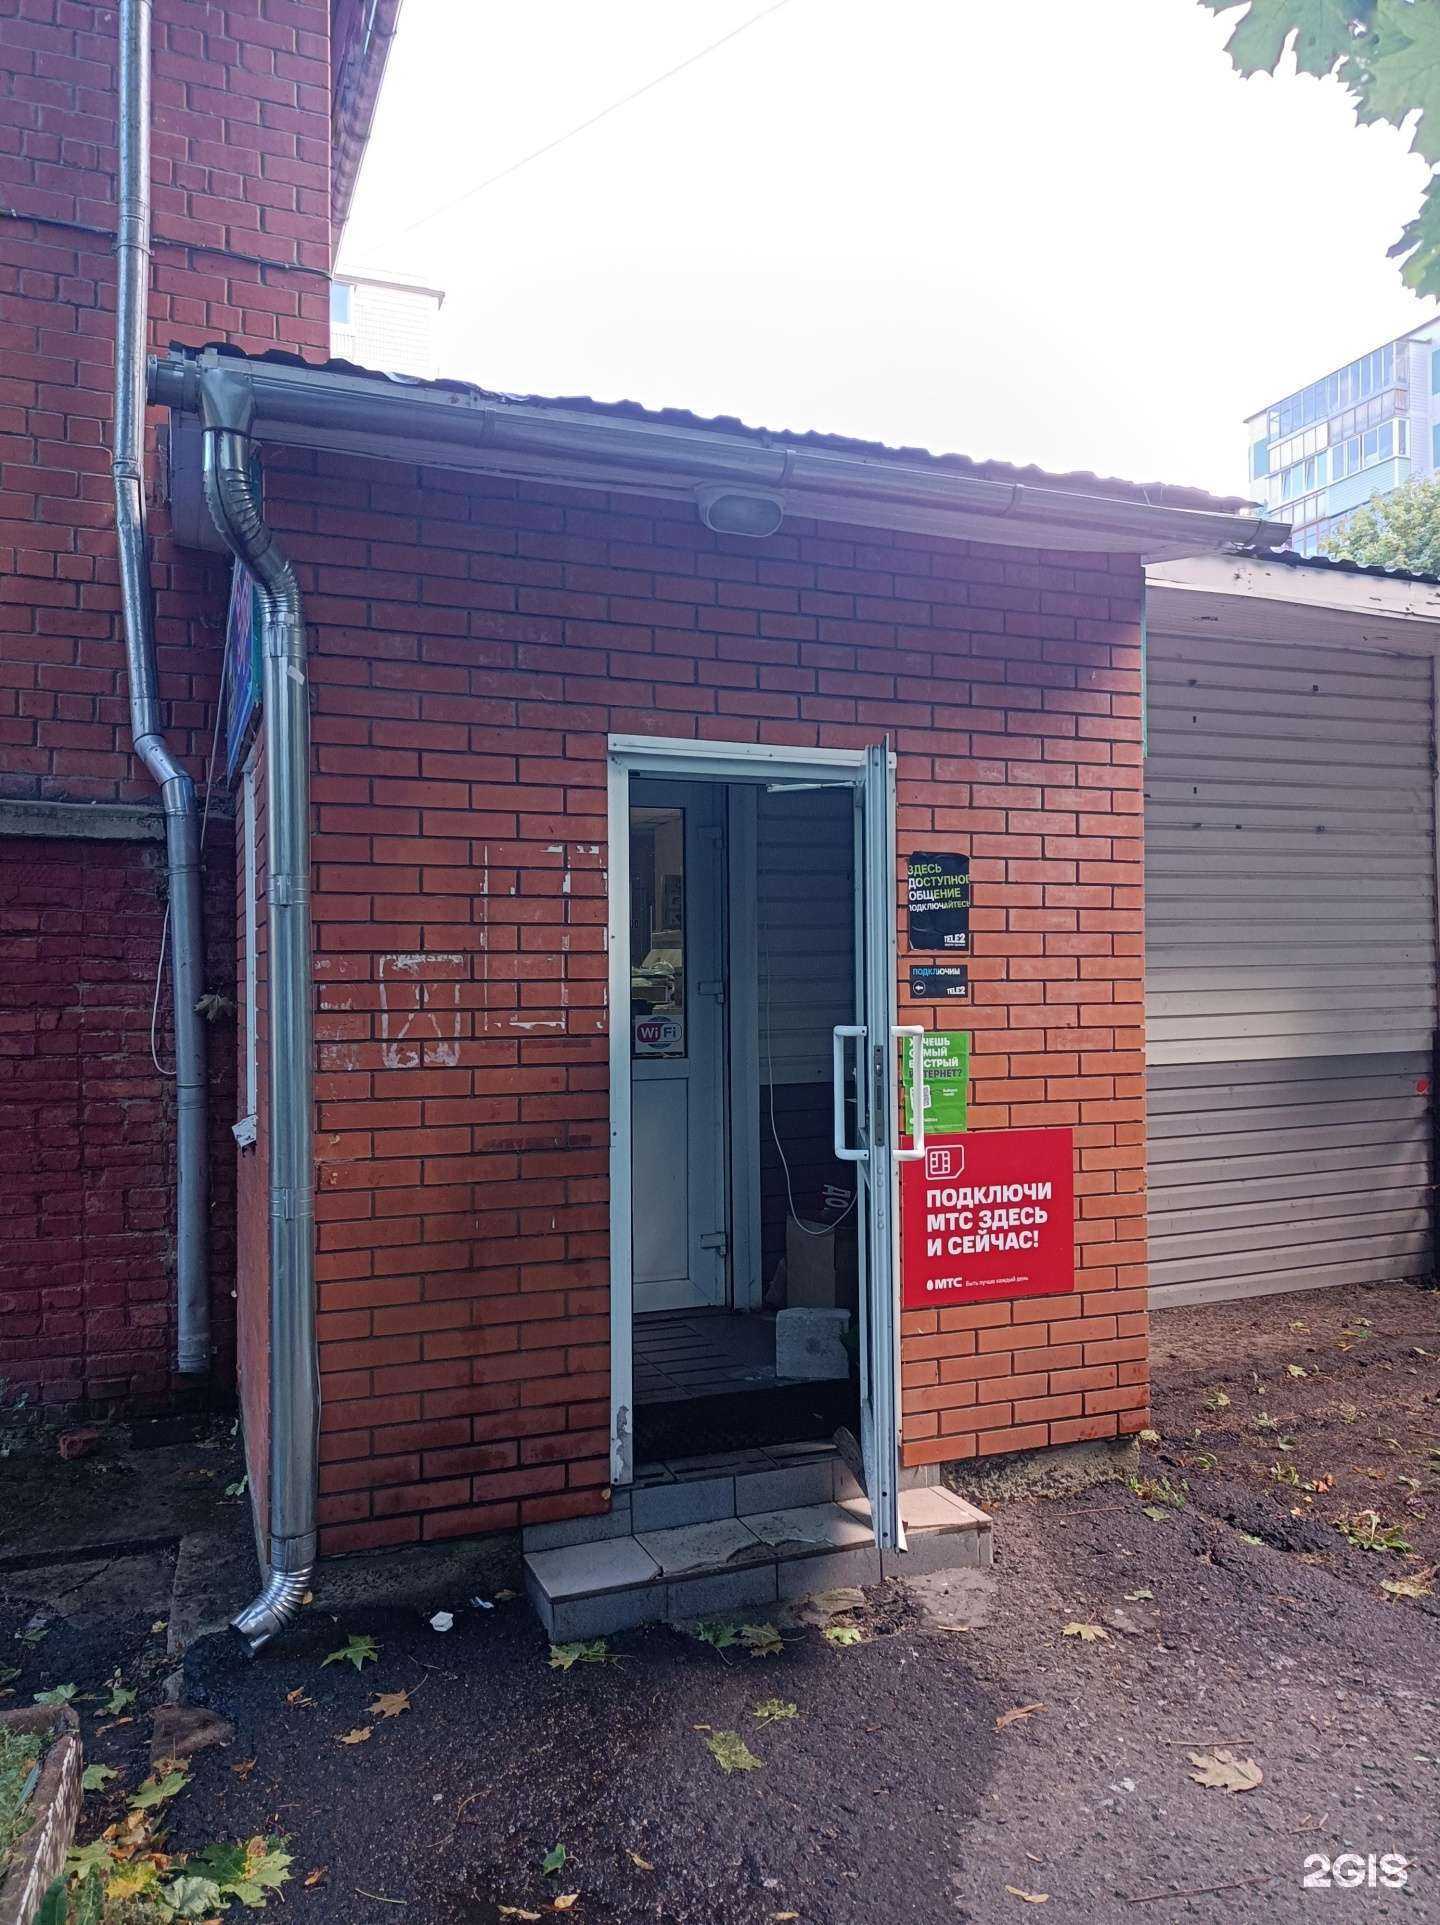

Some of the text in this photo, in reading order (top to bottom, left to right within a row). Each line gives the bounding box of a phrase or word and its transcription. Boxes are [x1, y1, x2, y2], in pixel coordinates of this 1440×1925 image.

[908, 864, 942, 876] ЗДЕСЬ
[909, 887, 961, 901] ОБЩЕНИЕ
[944, 933, 966, 944] TELE2
[947, 986, 966, 995] TELE2
[909, 1047, 948, 1058] СМЫЙ
[927, 1182, 1052, 1209] ПОДКЛЮЧИ
[927, 1206, 1048, 1232] МТС ЗДЕСЬ
[927, 1229, 1039, 1257] И СЕЙЧАС!
[934, 1277, 963, 1289] МТС
